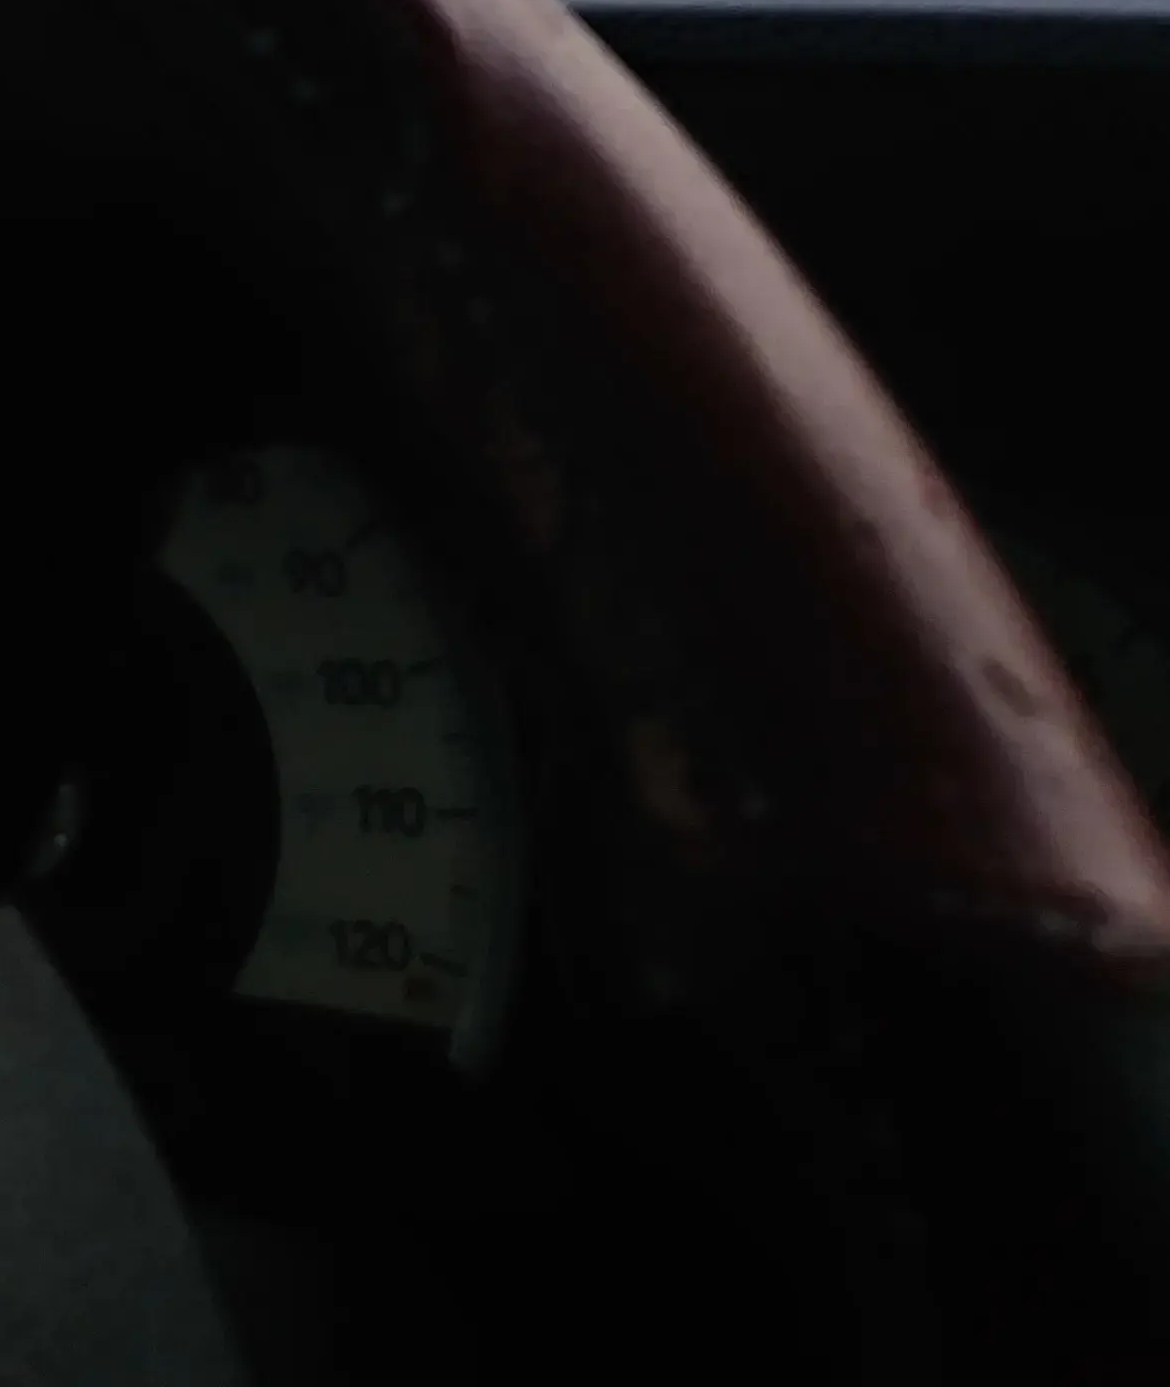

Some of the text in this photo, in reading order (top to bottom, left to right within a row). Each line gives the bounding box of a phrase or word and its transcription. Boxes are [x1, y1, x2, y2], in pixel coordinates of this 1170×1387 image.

[280, 548, 346, 598] 90
[316, 657, 401, 708] 100
[352, 784, 425, 837] 110
[329, 918, 413, 971] 120
